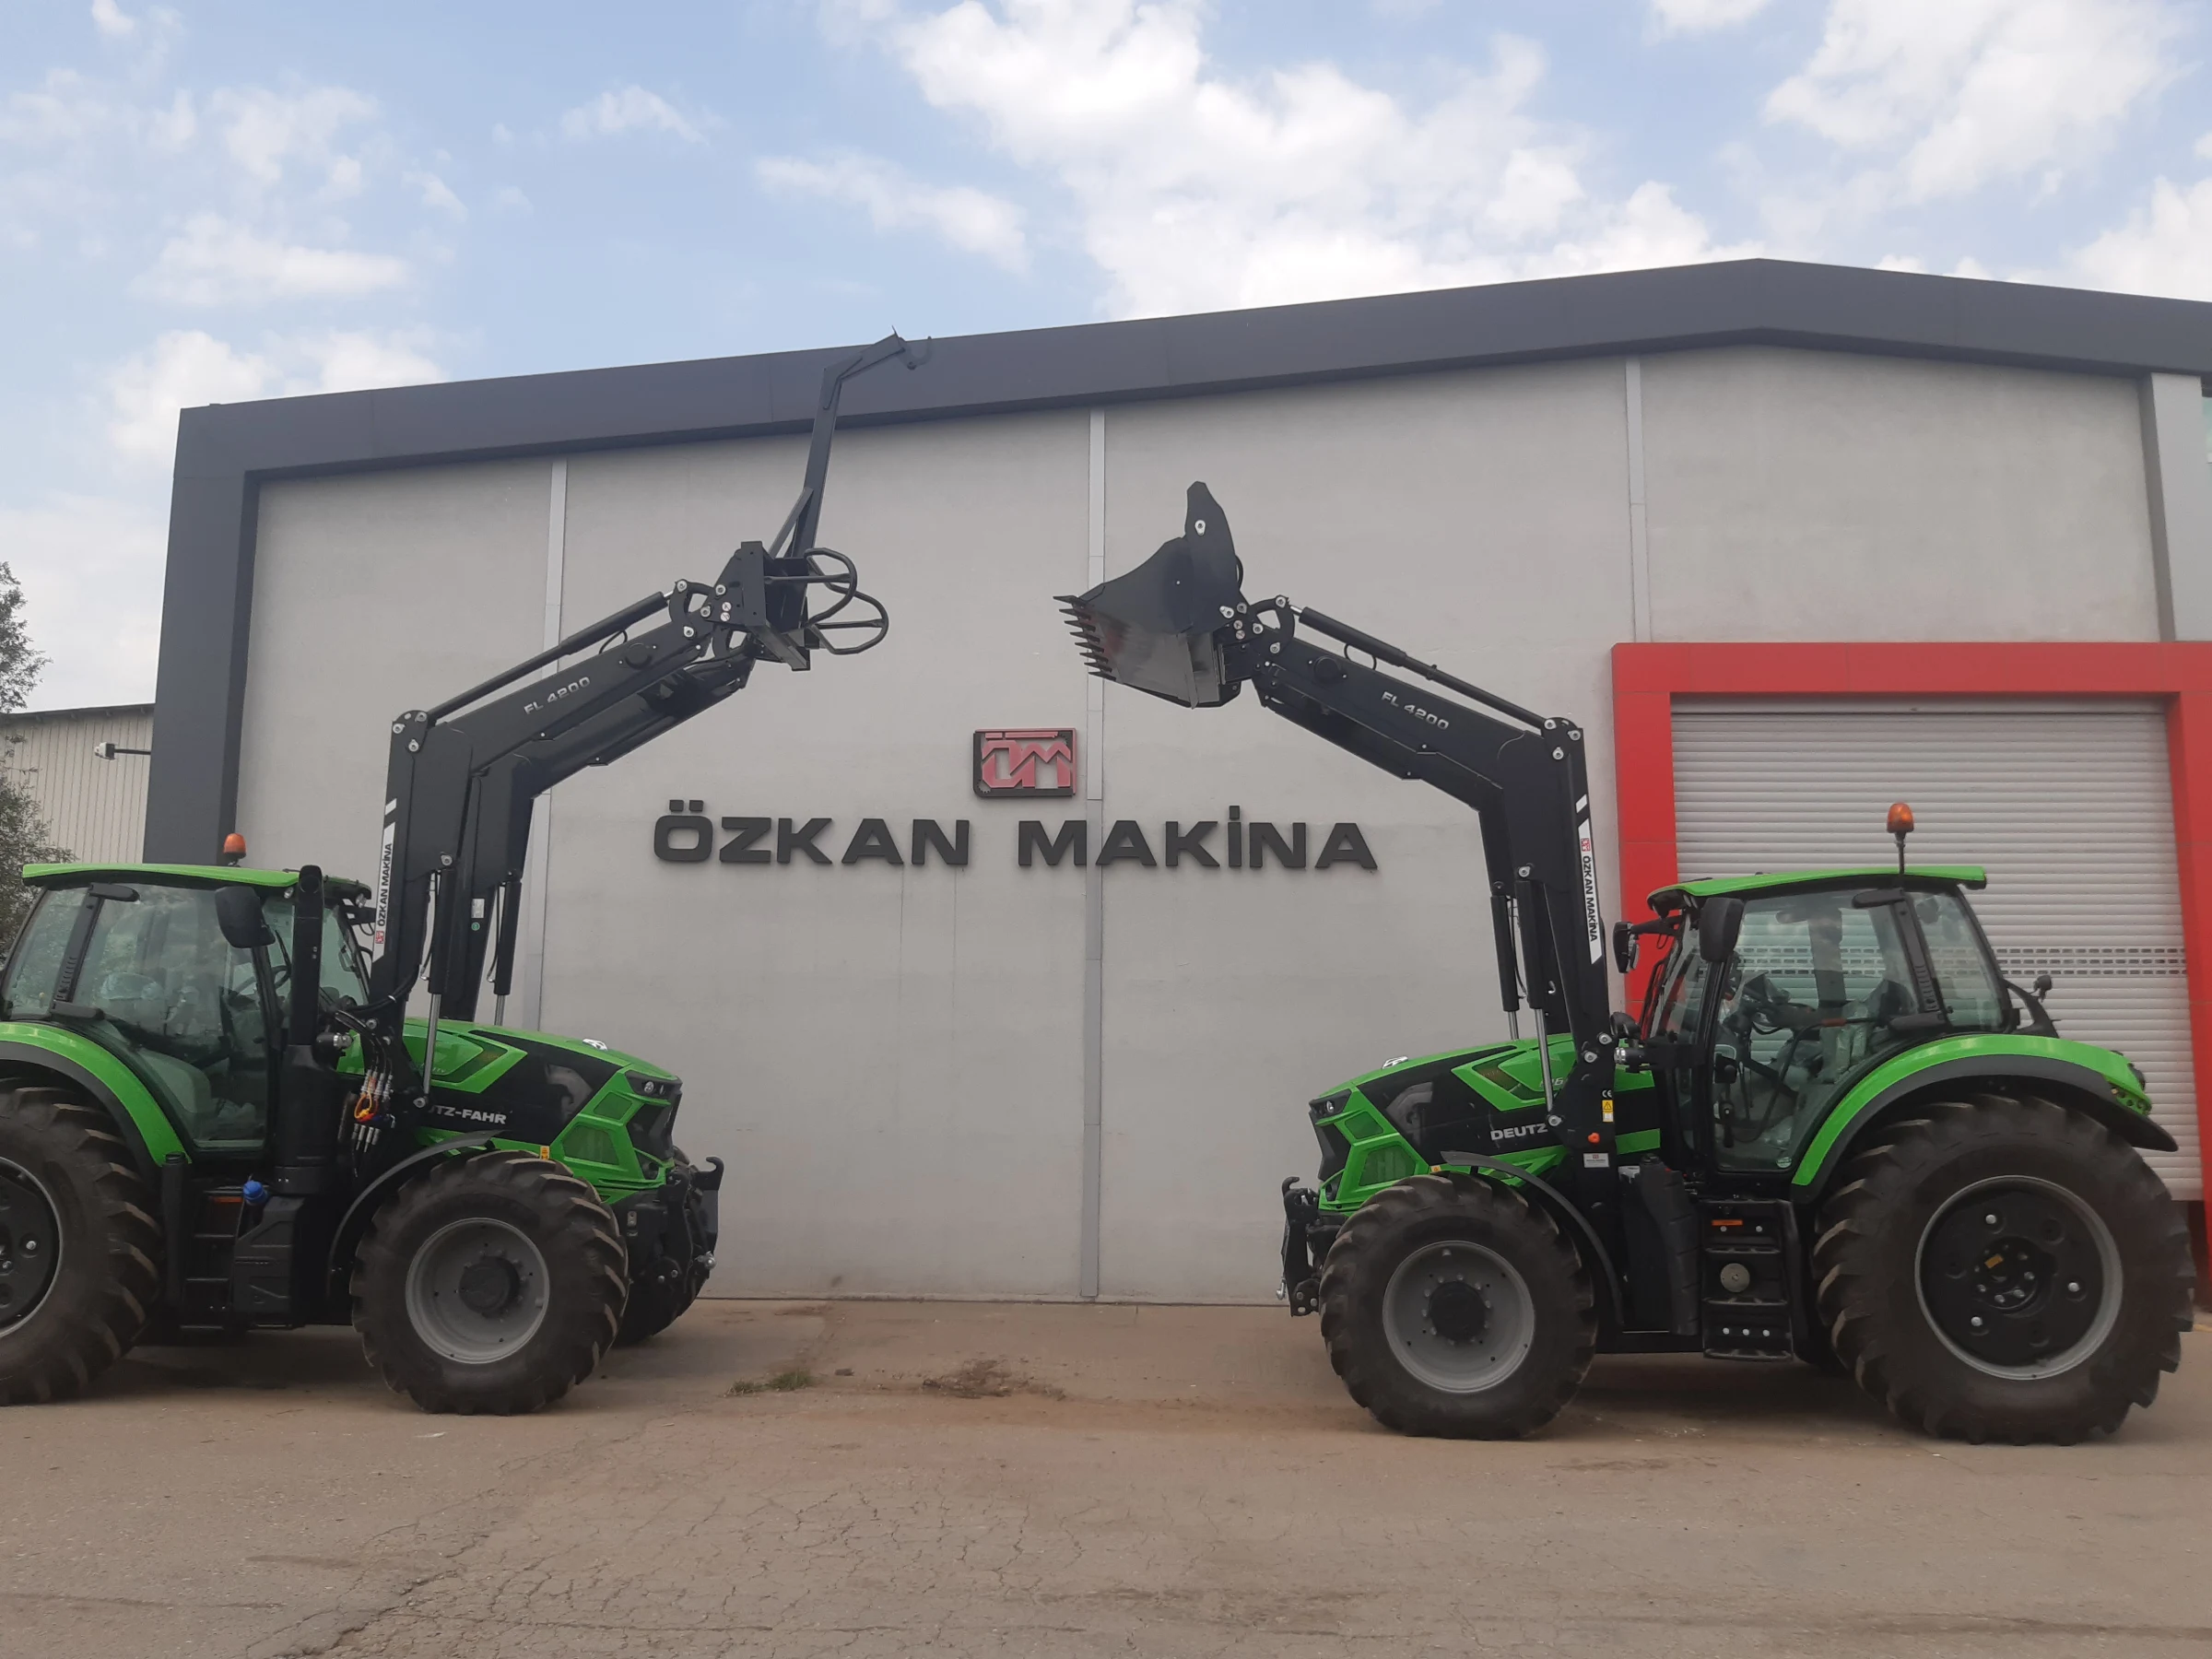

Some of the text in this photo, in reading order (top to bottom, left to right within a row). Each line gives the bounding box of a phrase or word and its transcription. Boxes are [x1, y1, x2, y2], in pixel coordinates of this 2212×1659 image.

[524, 677, 591, 715] FL 4200
[1381, 691, 1449, 730] FL 4200
[653, 799, 1378, 869] ÖZKAN MAKİNA
[382, 842, 393, 887] MAKİNA
[1583, 855, 1594, 895] ÖZKAN
[377, 888, 388, 927] ÖZKAN
[1586, 897, 1598, 942] MAKİNA
[1490, 1123, 1548, 1141] DEUTZ
